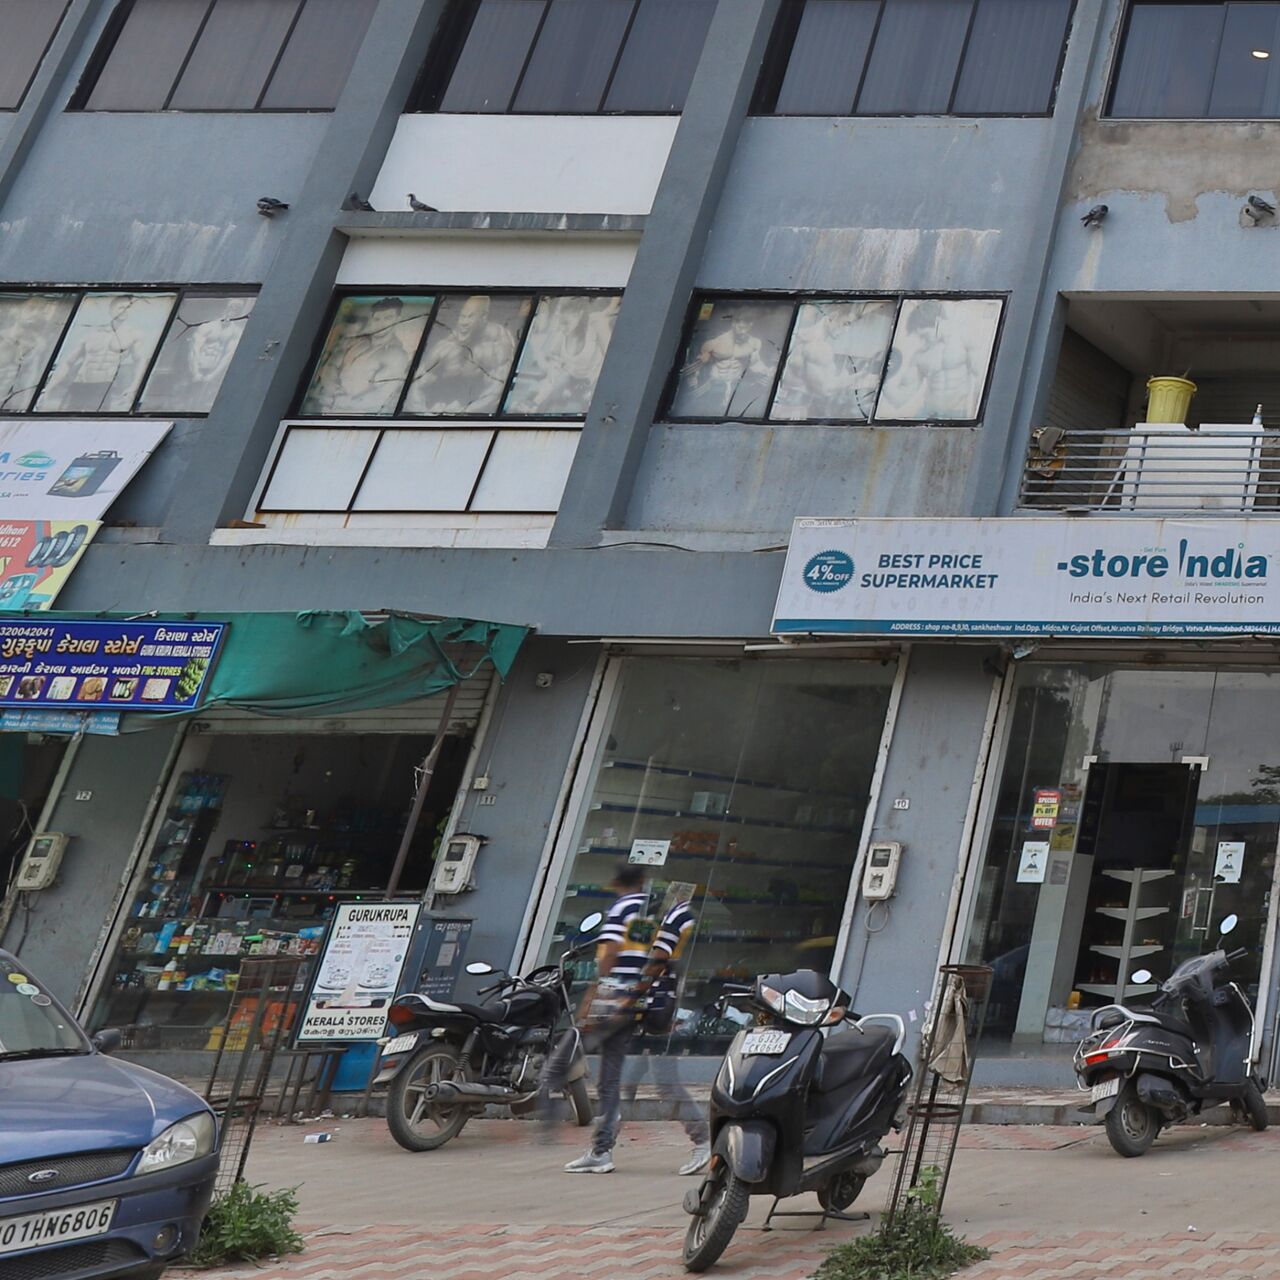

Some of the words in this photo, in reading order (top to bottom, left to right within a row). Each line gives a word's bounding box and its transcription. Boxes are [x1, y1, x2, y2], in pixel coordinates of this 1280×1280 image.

[878, 554, 924, 568] BEST
[928, 554, 983, 568] PRICE
[1180, 538, 1267, 579] India
[860, 574, 998, 589] SUPERMARKET
[1069, 592, 1112, 603] India's
[1117, 592, 1147, 603] Next
[1152, 592, 1190, 603] Retail
[1194, 592, 1264, 604] Revolution
[897, 800, 906, 808] 10
[348, 909, 408, 922] GURUKRUPA
[305, 1017, 344, 1027] KERALA
[347, 1016, 386, 1026] STORES
